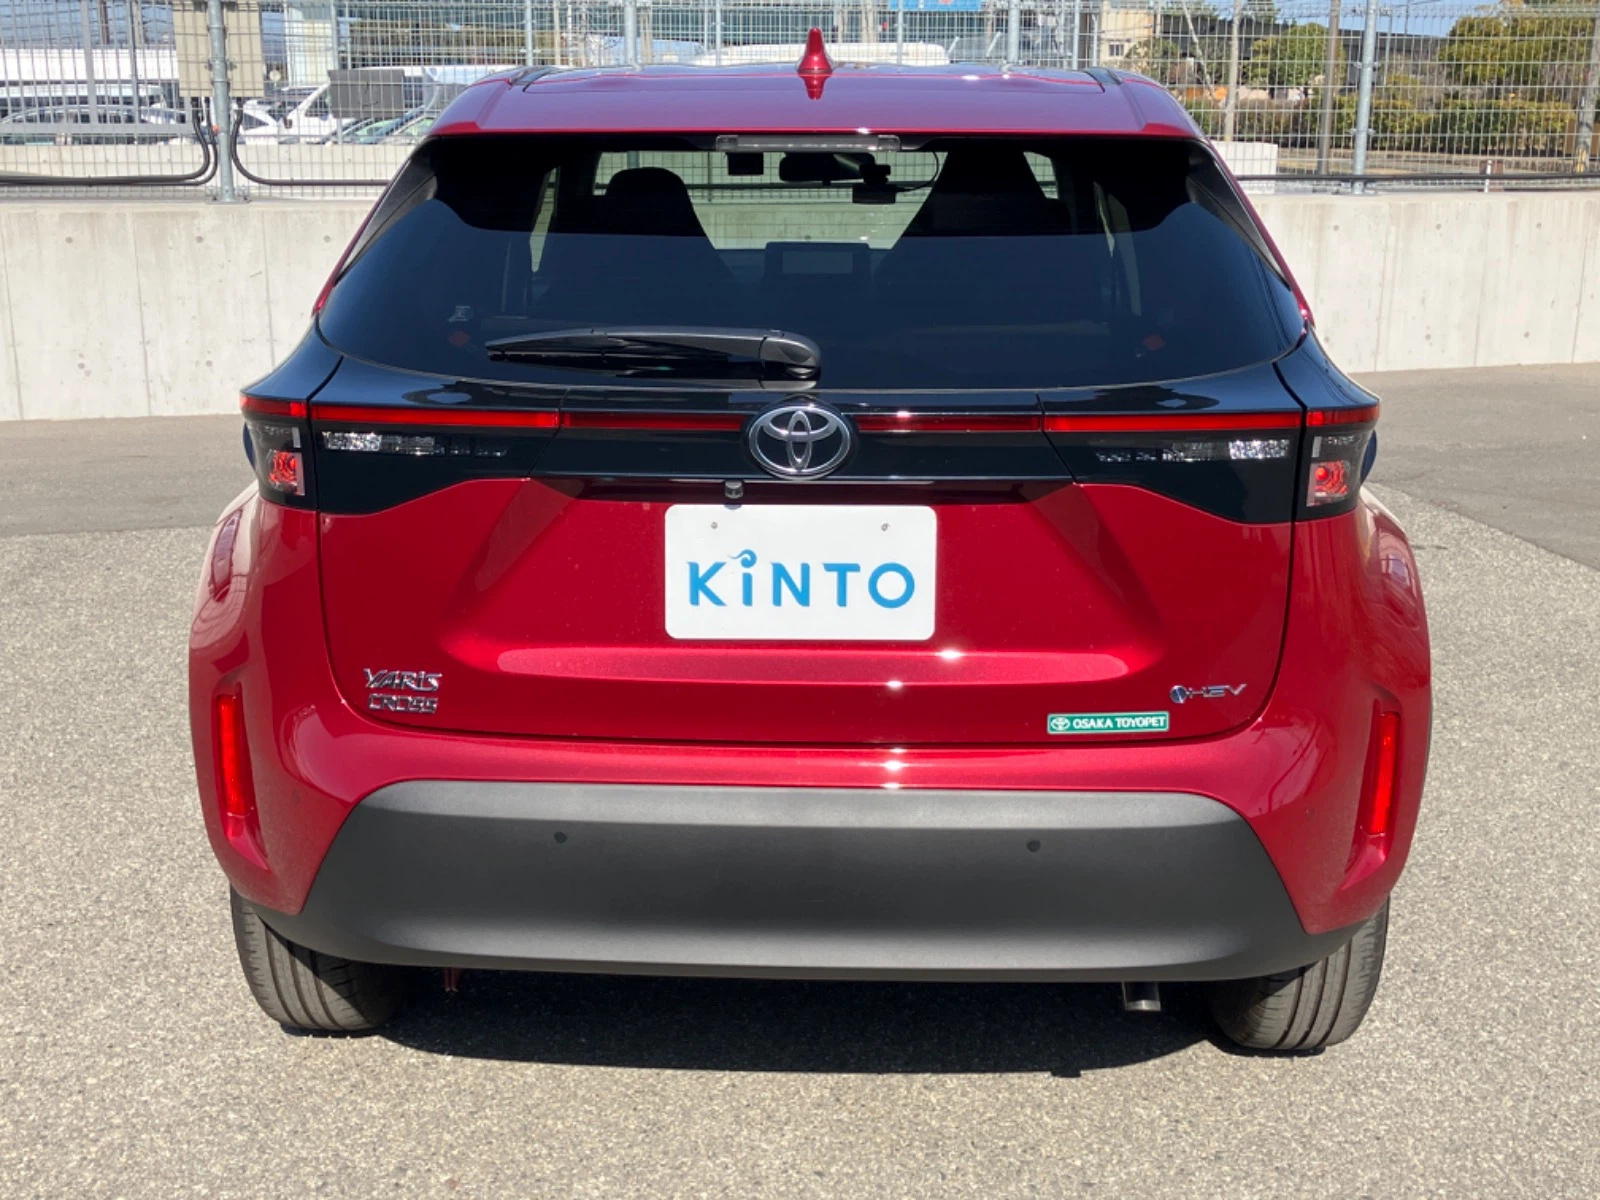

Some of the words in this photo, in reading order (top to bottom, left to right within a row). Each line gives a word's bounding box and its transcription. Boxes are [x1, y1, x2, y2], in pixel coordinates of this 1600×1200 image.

[363, 668, 443, 692] YARIS
[368, 693, 438, 714] CROSS
[1072, 718, 1113, 729] OSAKA
[1115, 716, 1166, 728] TOYOPET
